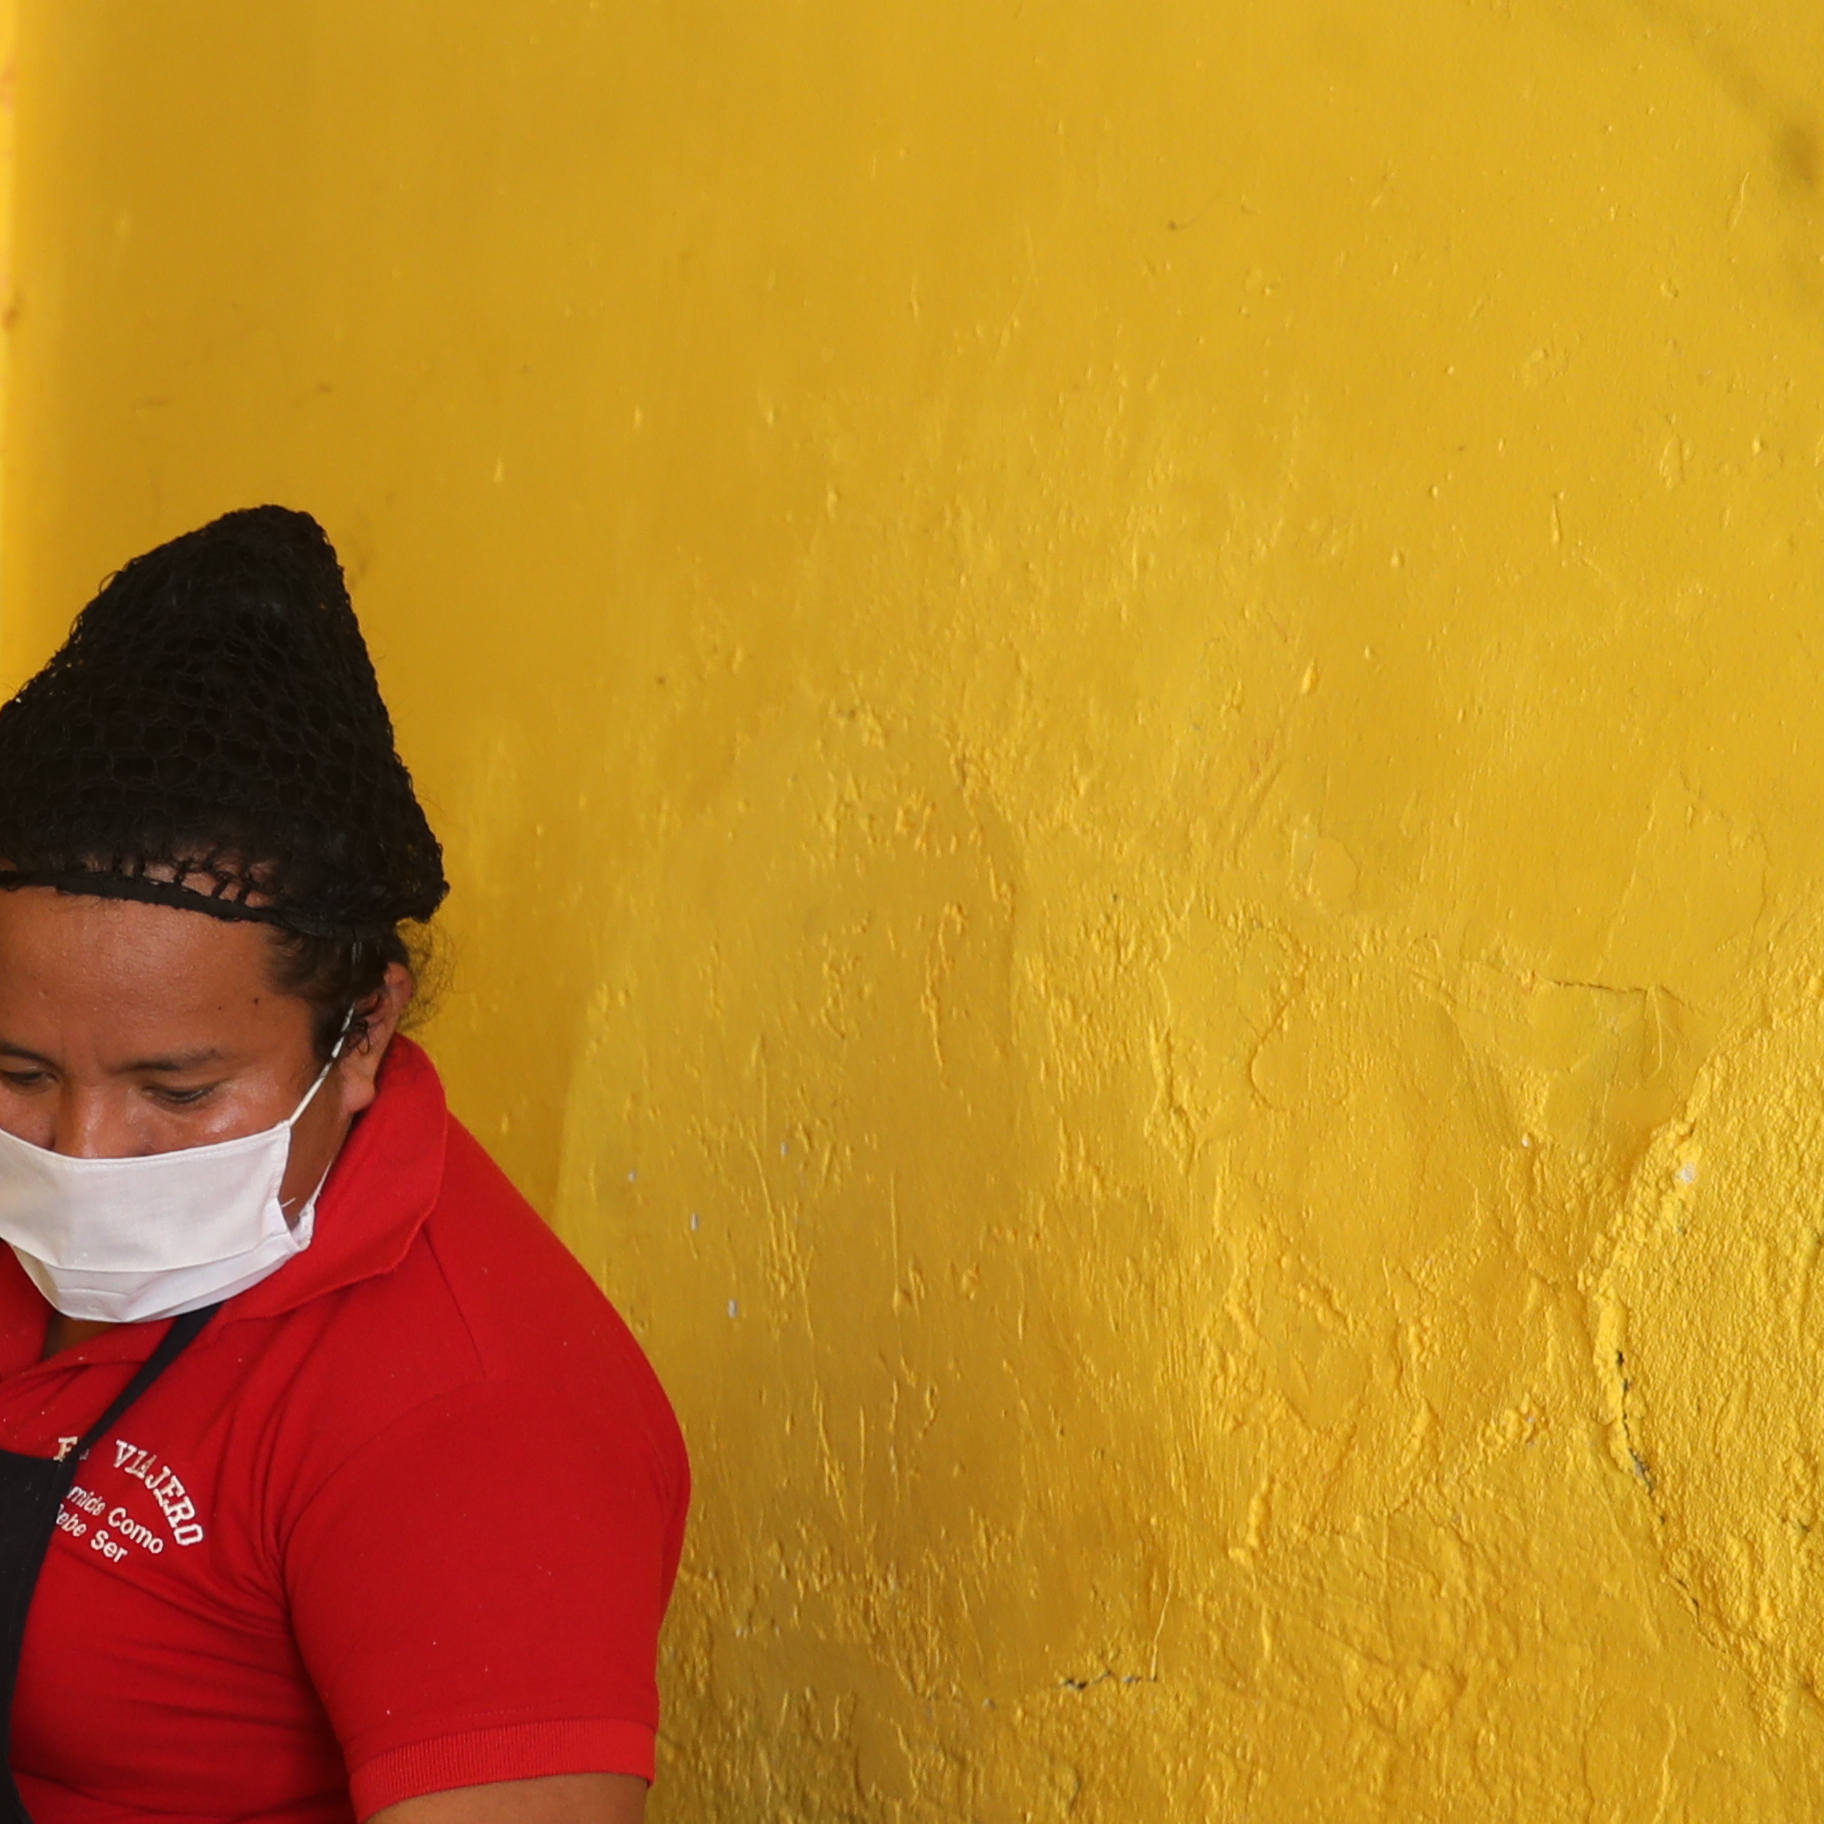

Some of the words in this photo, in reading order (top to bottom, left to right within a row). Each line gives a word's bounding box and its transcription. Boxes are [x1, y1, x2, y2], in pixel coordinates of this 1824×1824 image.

[66, 1485, 106, 1516] mida
[108, 1507, 164, 1554] Como
[113, 1439, 204, 1546] VIAJERO
[55, 1503, 87, 1537] ebe
[90, 1530, 128, 1563] Ser
